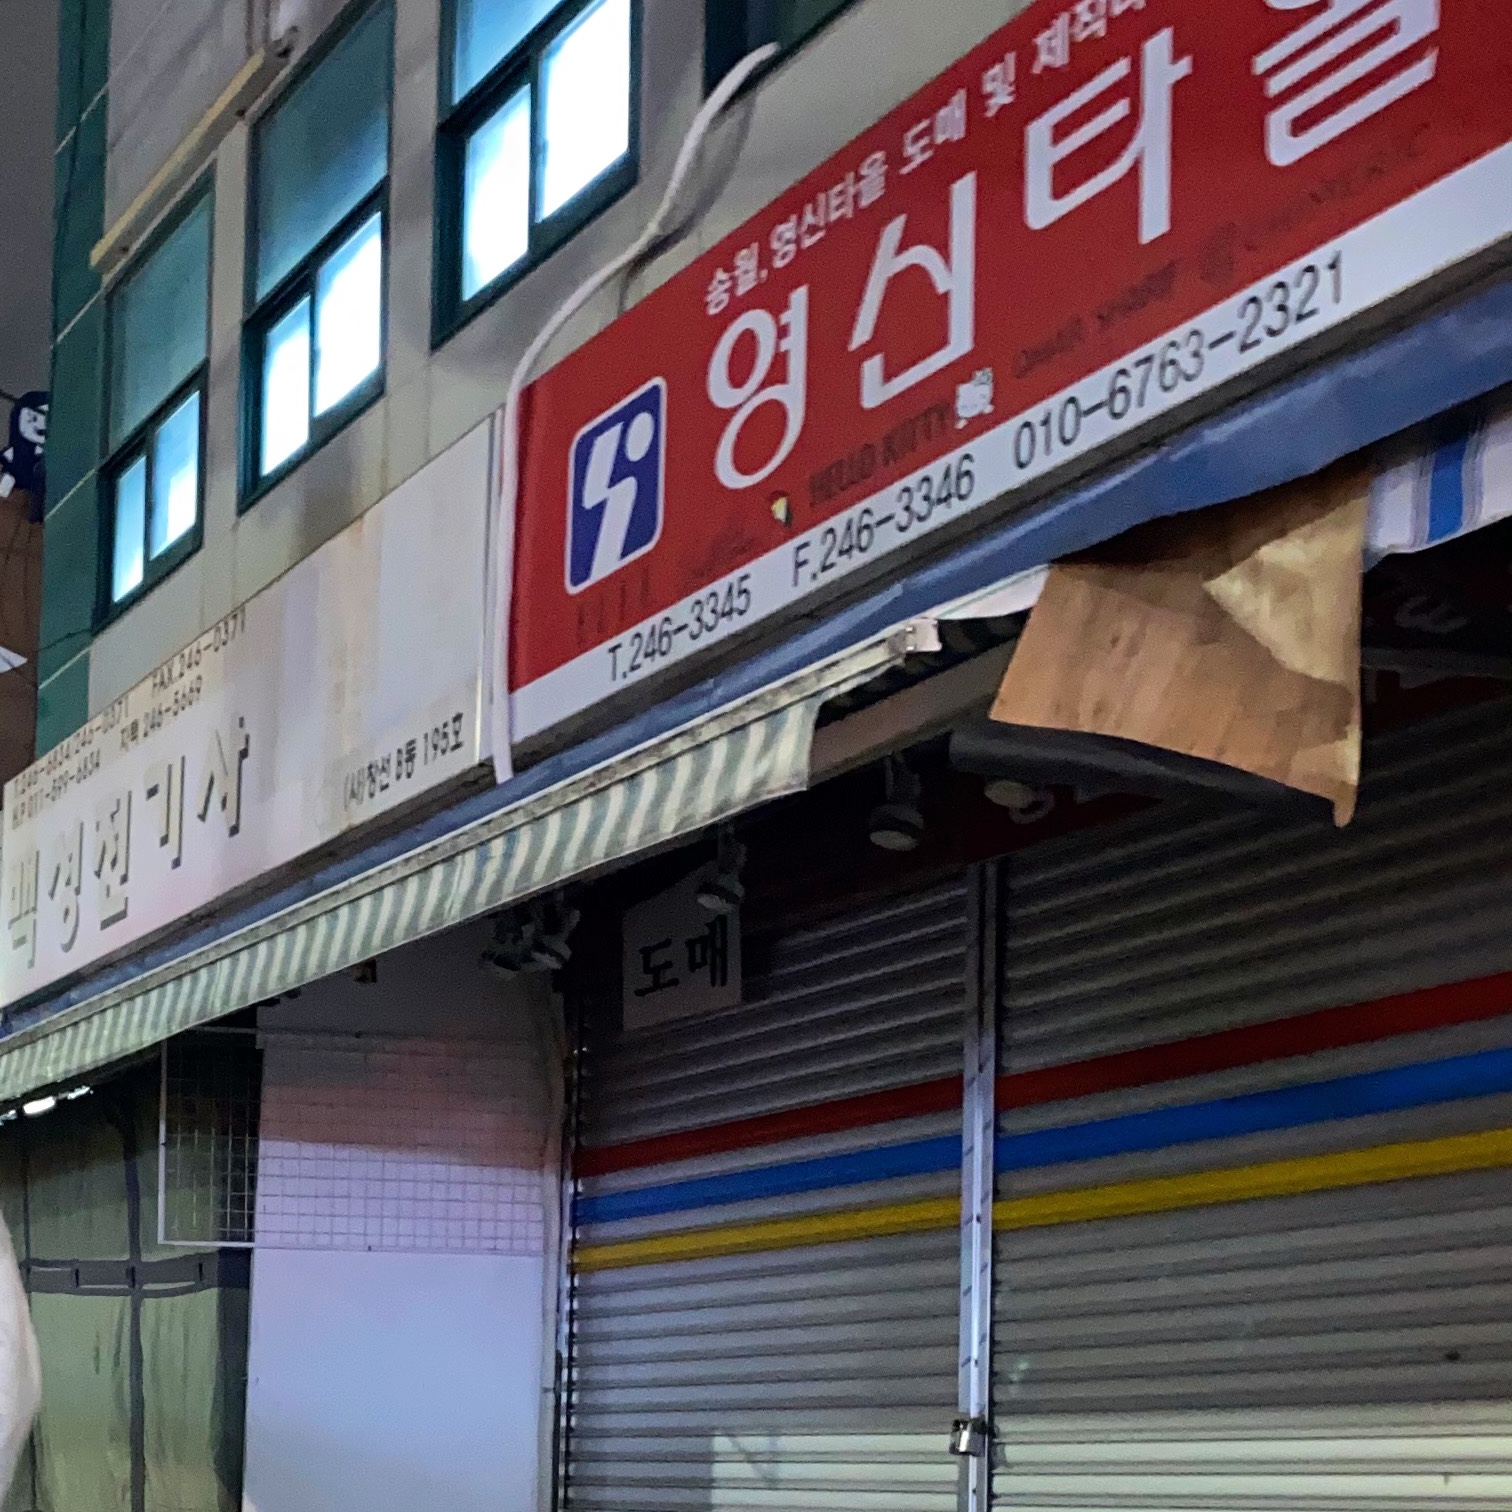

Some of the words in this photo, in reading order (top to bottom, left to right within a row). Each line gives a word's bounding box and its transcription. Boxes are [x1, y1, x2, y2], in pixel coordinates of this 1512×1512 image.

[899, 88, 968, 176] 도매
[981, 51, 1017, 118] 및
[607, 573, 753, 683] T.246-3345
[791, 452, 975, 588] F.246-3346
[1013, 249, 1344, 470] 010-6763-2321
[633, 913, 728, 998] 도매
